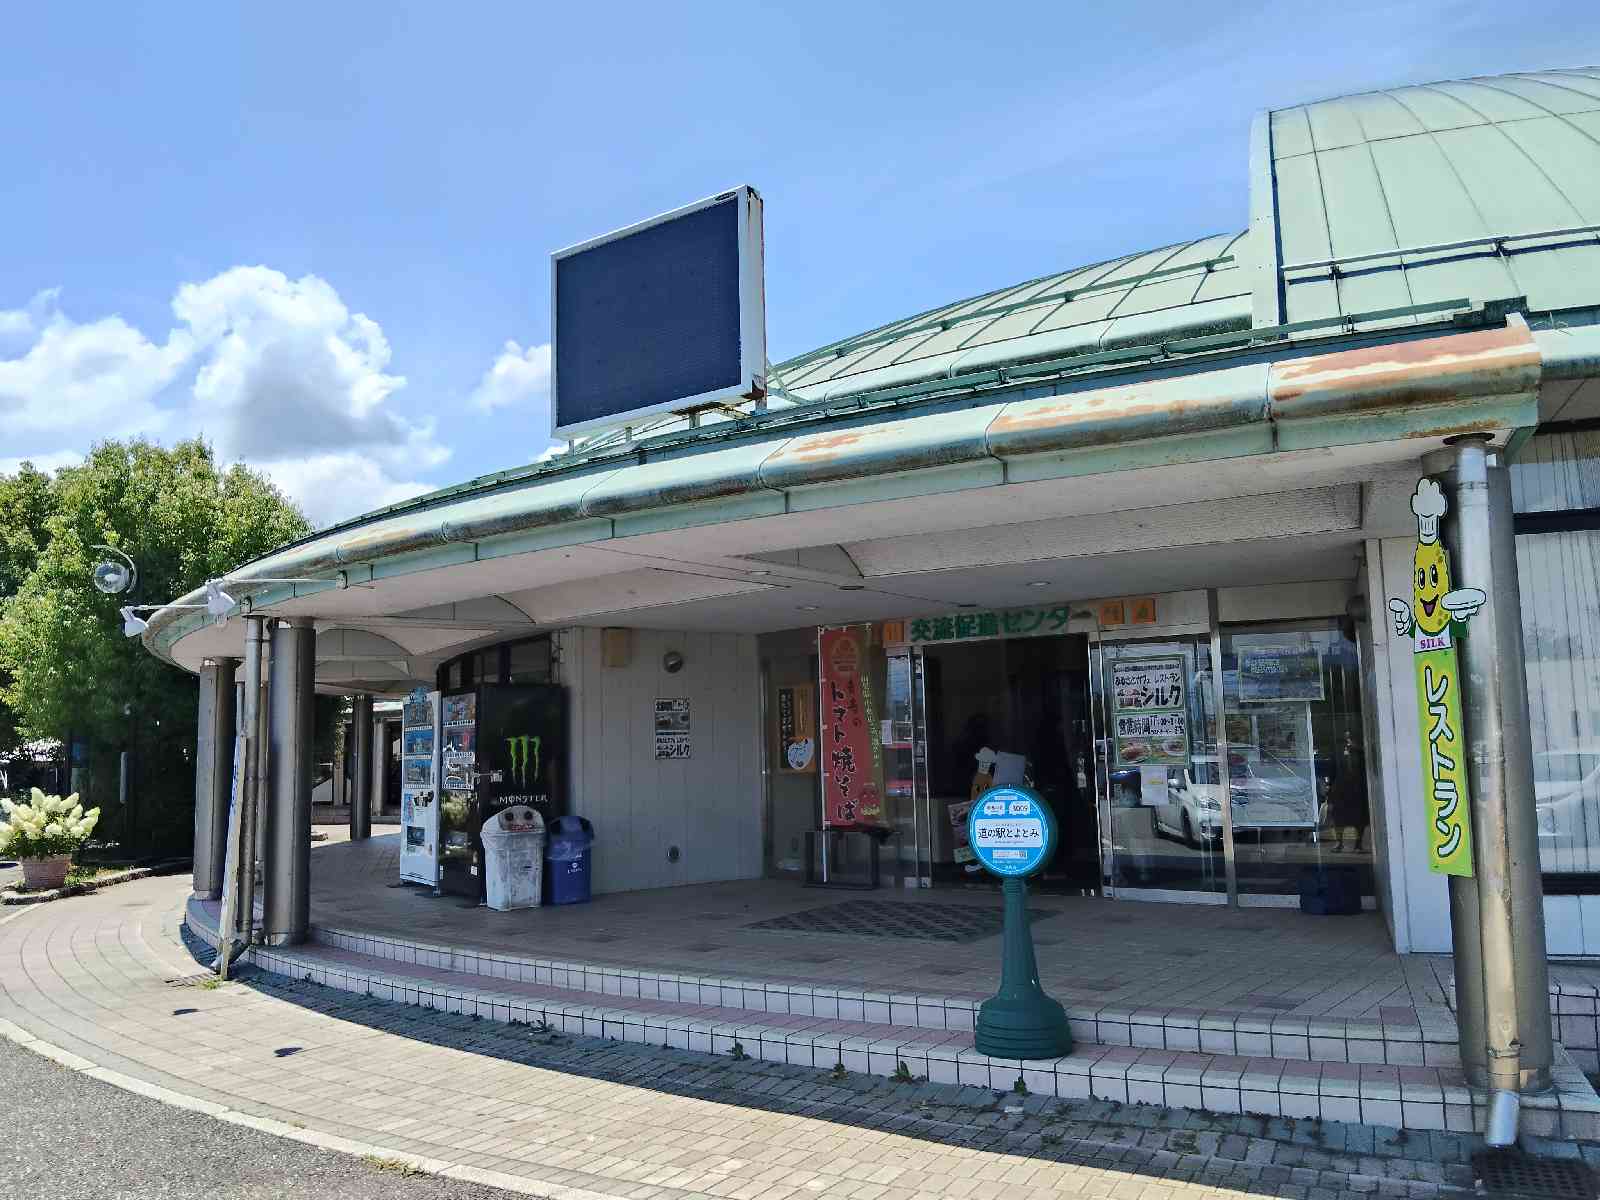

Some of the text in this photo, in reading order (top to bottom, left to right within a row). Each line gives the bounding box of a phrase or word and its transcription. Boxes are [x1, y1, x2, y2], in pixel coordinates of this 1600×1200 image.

[911, 608, 1094, 642] 交流促進センター
[1420, 637, 1445, 650] SILK
[1154, 673, 1180, 684] レストラン
[1141, 685, 1181, 706] シルク
[1424, 666, 1461, 858] レストラン
[499, 794, 548, 805] MONSTER
[978, 828, 1040, 839] 道の駅とよとみ
